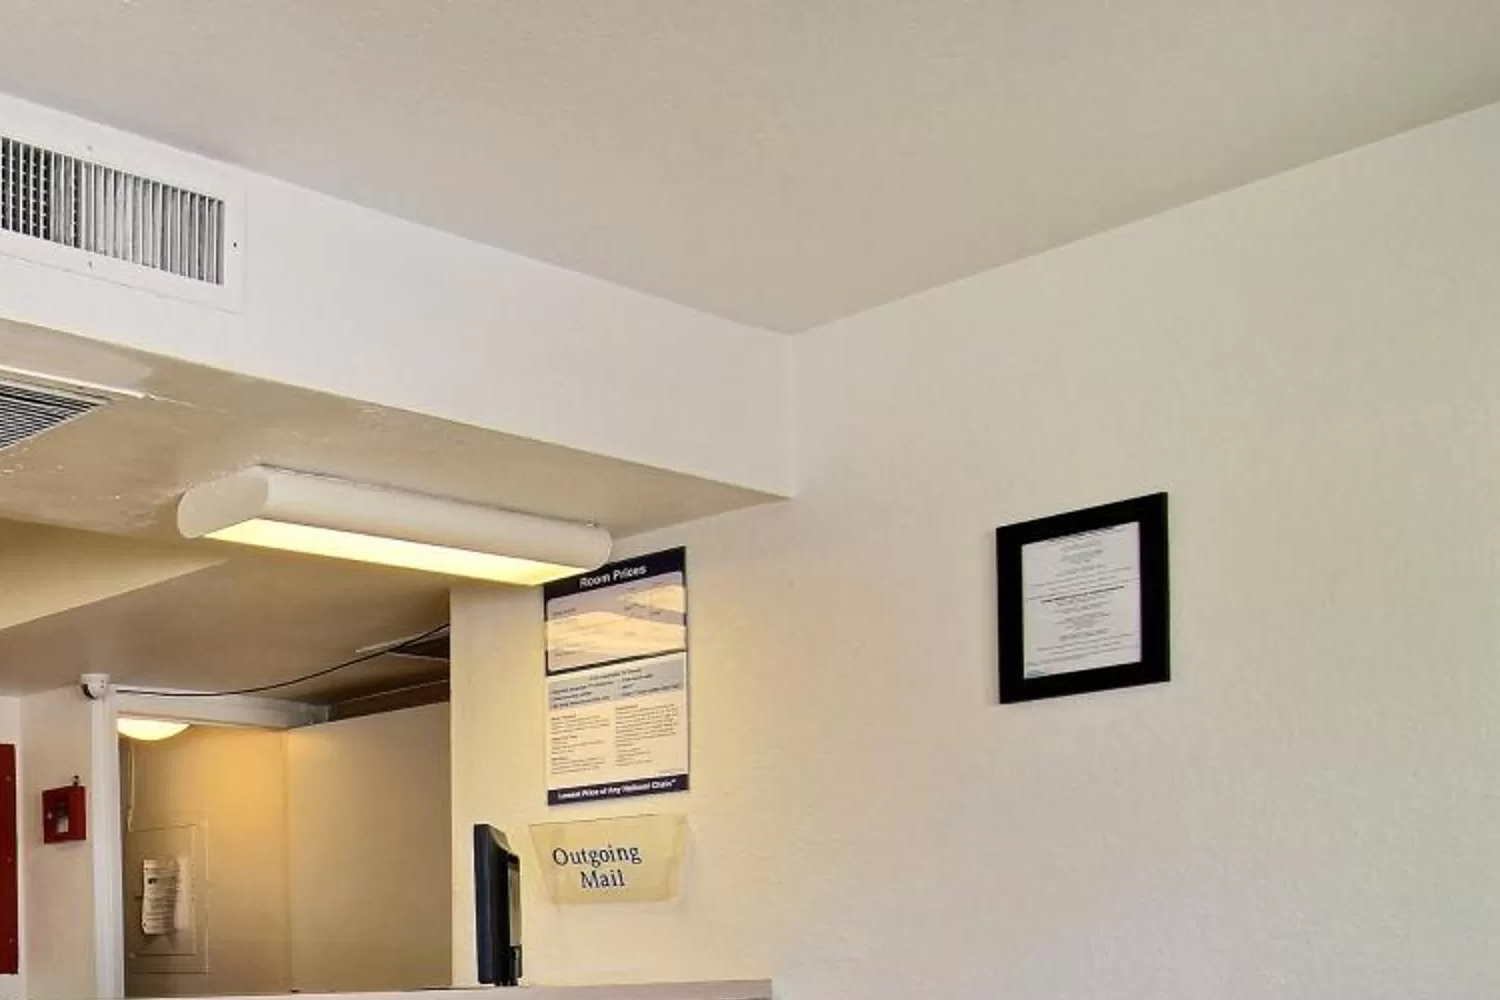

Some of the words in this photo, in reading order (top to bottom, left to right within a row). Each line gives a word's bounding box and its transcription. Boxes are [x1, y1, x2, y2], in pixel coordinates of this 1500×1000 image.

[579, 574, 611, 588] Room
[614, 566, 647, 580] Prices
[582, 788, 598, 797] Price
[608, 786, 621, 795] Any
[552, 843, 643, 867] Outgoing
[580, 870, 625, 889] Mail
